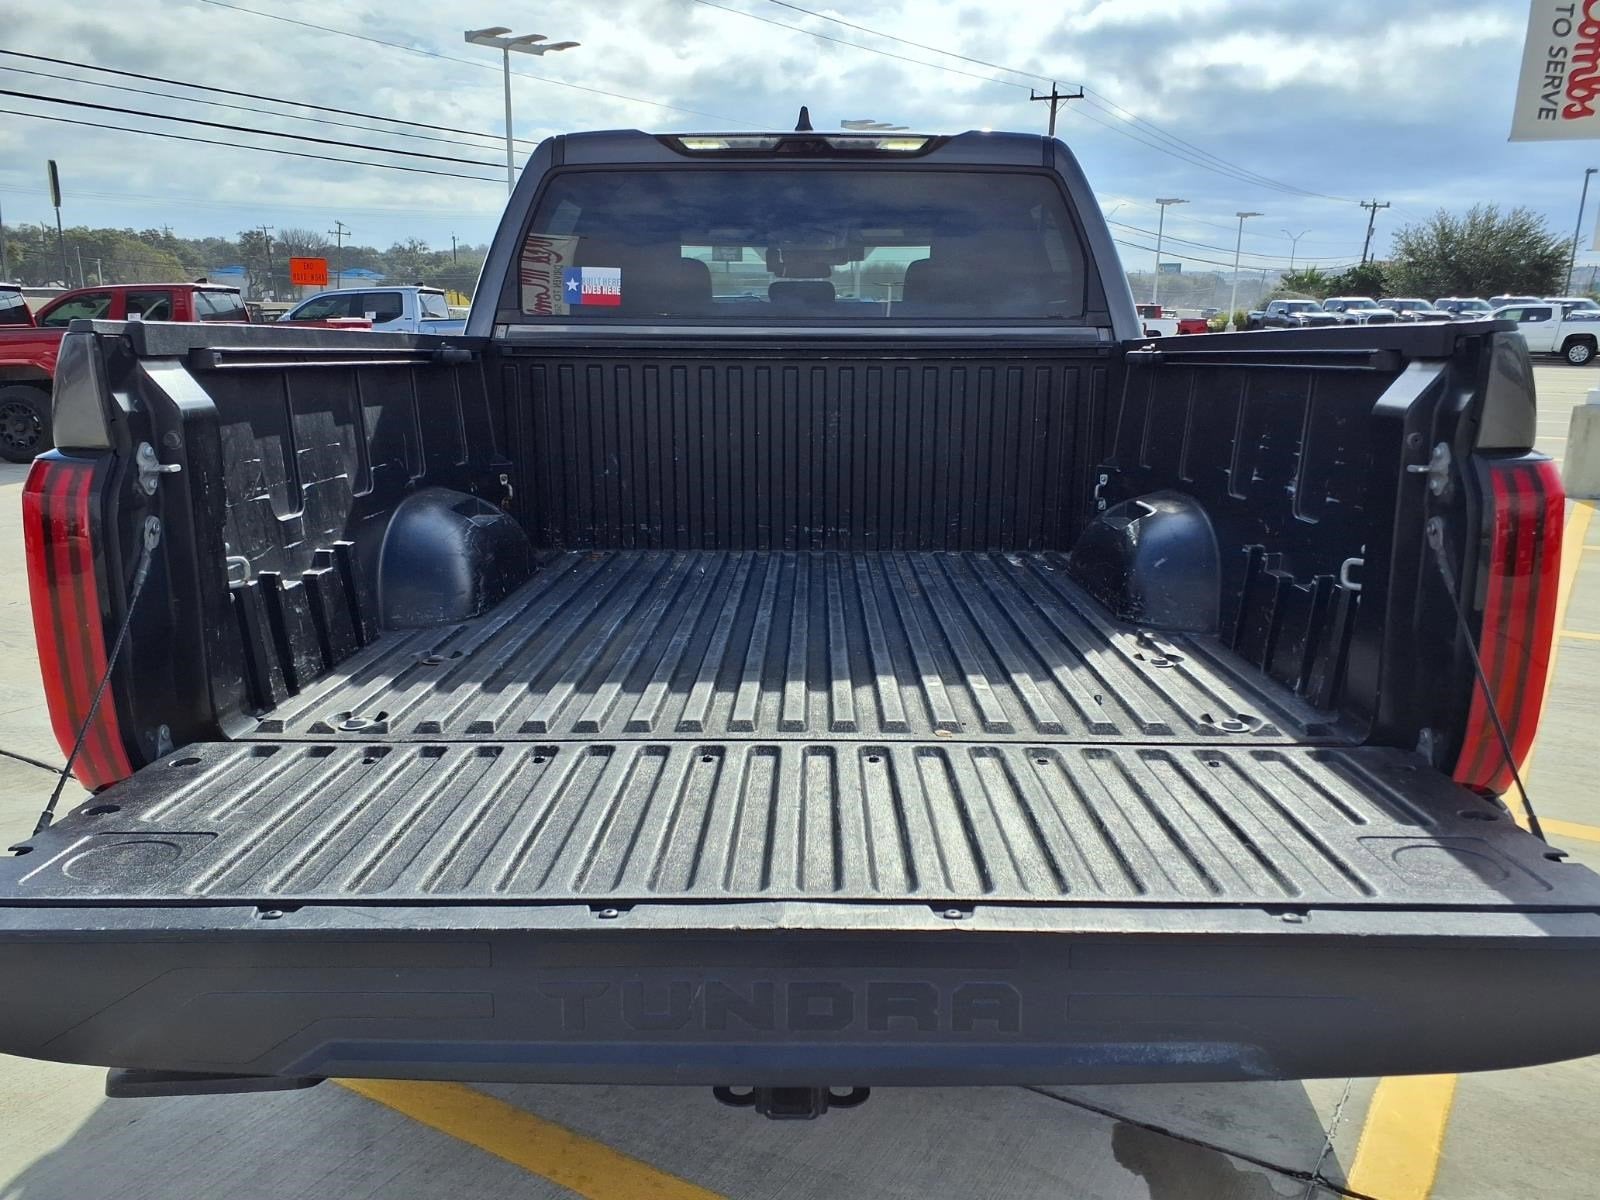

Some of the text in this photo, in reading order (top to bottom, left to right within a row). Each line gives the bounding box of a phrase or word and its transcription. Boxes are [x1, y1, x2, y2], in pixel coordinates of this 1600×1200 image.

[1537, 3, 1575, 121] TO SERVE
[582, 285, 621, 295] LIVES HERE
[536, 980, 1024, 1034] TUNDRA
